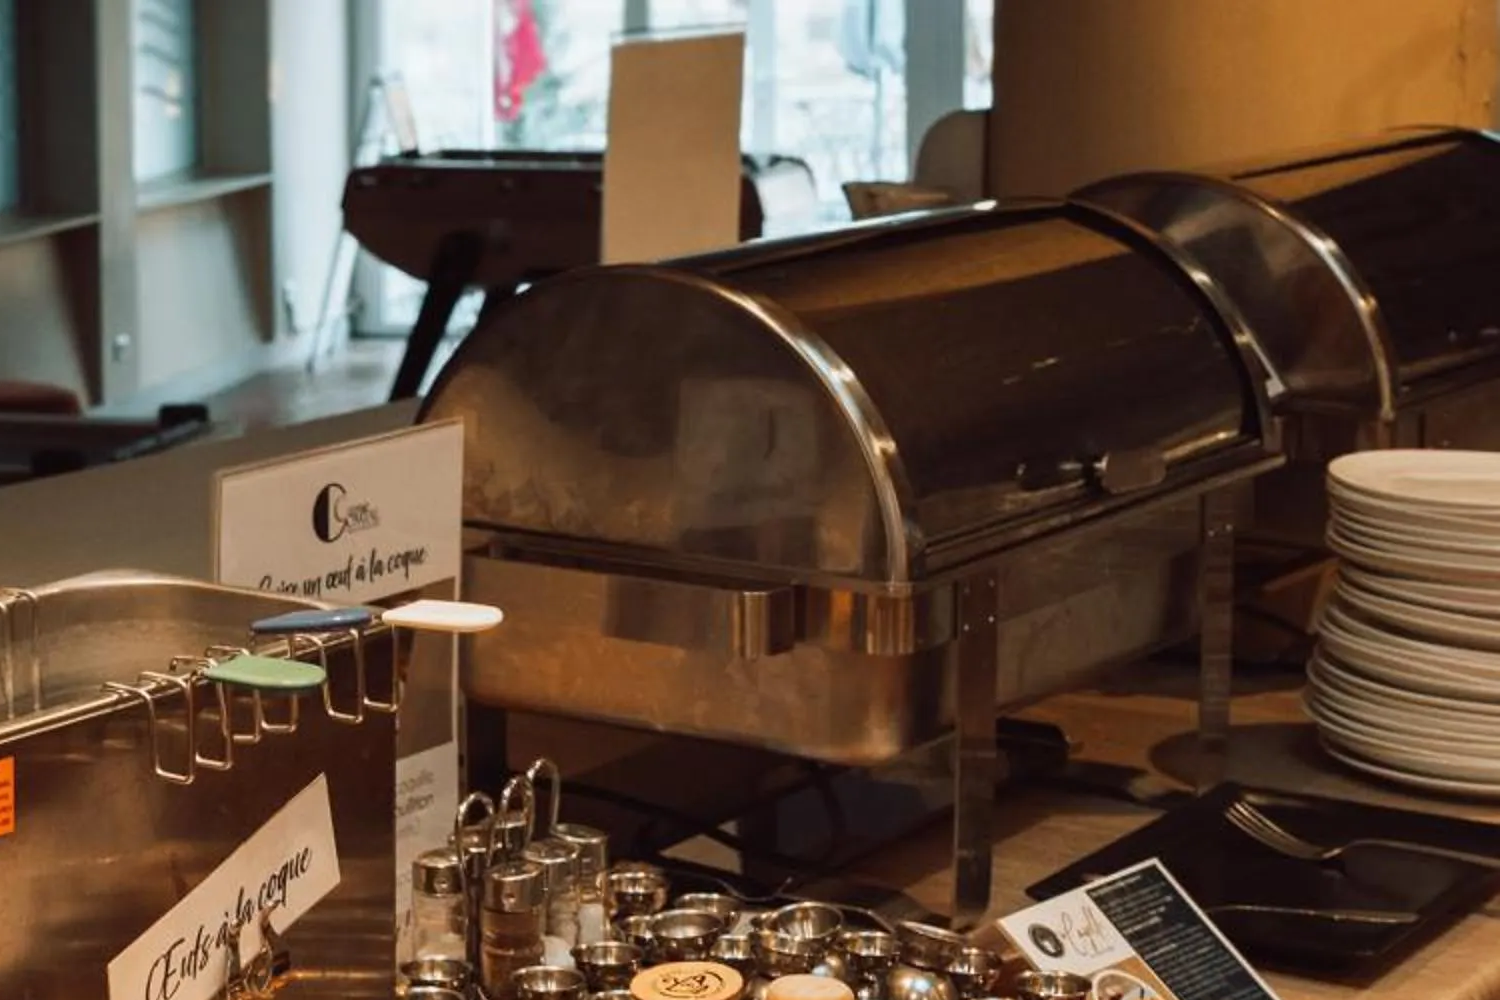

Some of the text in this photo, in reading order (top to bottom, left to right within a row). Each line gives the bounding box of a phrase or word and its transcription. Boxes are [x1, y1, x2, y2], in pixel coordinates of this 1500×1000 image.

[369, 547, 384, 583] la
[387, 547, 425, 581] coque
[235, 886, 255, 923] la
[257, 847, 312, 911] coque
